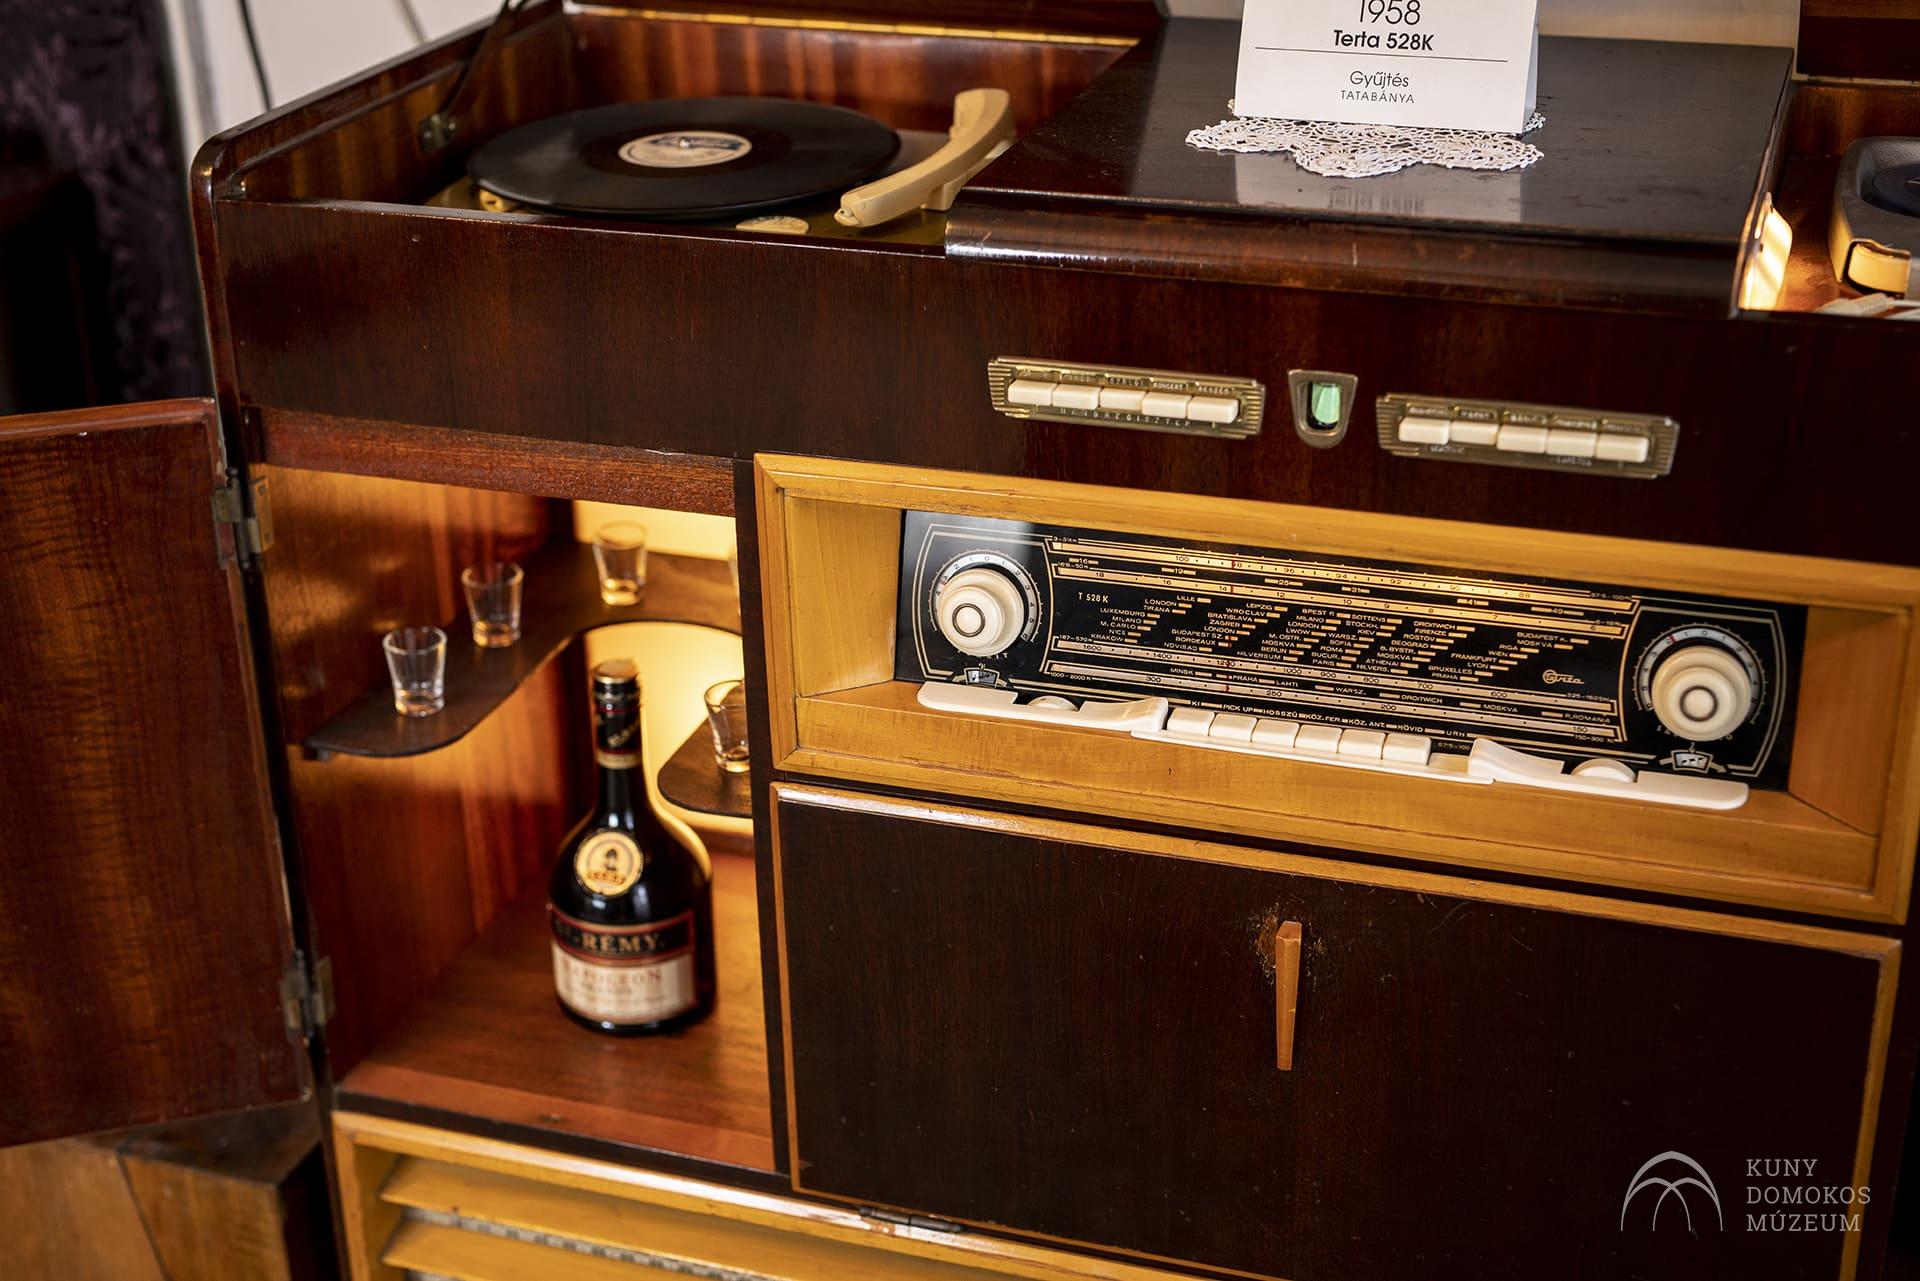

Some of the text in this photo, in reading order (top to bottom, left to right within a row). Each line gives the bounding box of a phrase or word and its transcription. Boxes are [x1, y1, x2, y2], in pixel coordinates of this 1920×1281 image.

[1359, 0, 1421, 25] 1958
[1333, 30, 1434, 50] Terta 528K
[1350, 70, 1409, 88] Gyűjtés
[1340, 89, 1415, 104] TATABÁNYA
[1103, 595, 1109, 603] K
[1100, 608, 1145, 617] LUXEMBURG
[1143, 605, 1170, 613] TIRANA
[1226, 608, 1265, 616] WROCLAV
[1112, 616, 1141, 624] MILANO
[1208, 612, 1252, 622] BRATISLAVA
[1352, 614, 1385, 622] SOTTENS
[1110, 622, 1136, 630] CARLO
[1210, 619, 1240, 627] ZAGREB
[1413, 621, 1455, 630] DROITWICH
[1172, 629, 1210, 638] BUDAPEST
[1204, 626, 1235, 634] LONDON
[1415, 628, 1447, 636] FIRENZE
[1091, 634, 1123, 642] KRAKOW
[1328, 632, 1357, 640] WARSZ.
[1403, 634, 1435, 642] ROSTOV
[1517, 632, 1558, 641] BUDAPEST
[1175, 637, 1216, 645] BORDEAUX
[1262, 640, 1295, 648] MOSKVA
[1391, 640, 1428, 648] BEOGRAD
[1517, 640, 1552, 648] MOSKVA
[1237, 651, 1281, 660] HILVERSUM
[1312, 652, 1340, 660] BUCUR.
[1377, 652, 1411, 661] MOSKVA
[1451, 653, 1497, 663] FRANKFURT
[1366, 658, 1399, 666] ATHENAI
[1357, 664, 1389, 672] HILVERS.
[1428, 666, 1472, 674] BRUXELLES
[1336, 687, 1366, 695] WARSZ.
[1402, 694, 1442, 703] DROITWICH
[1483, 704, 1518, 712] MOSKVA
[1397, 724, 1423, 733] RÖVID
